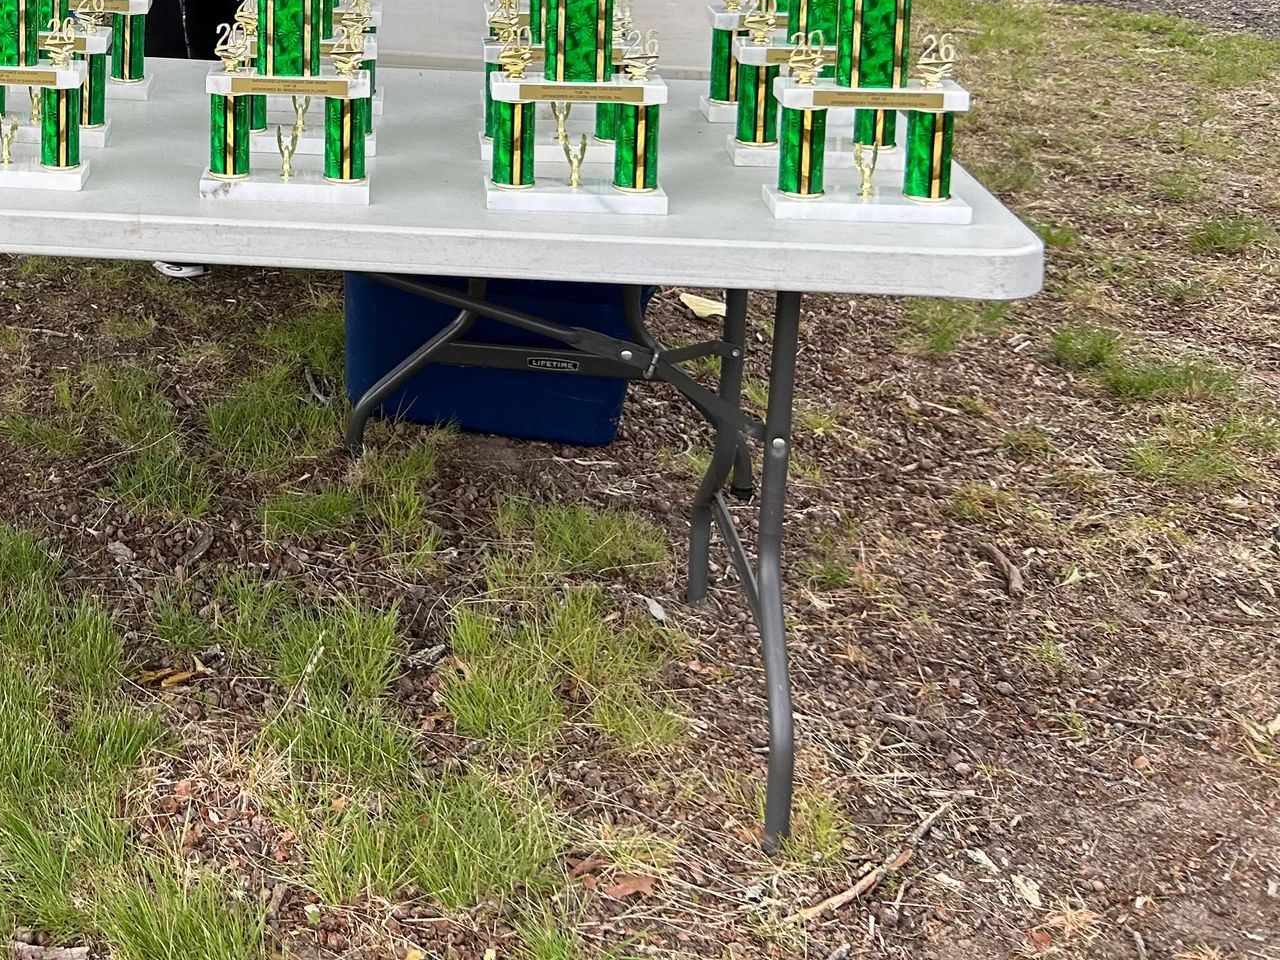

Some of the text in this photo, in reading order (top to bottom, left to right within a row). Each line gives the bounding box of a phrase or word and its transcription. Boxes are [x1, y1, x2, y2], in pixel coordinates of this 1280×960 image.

[45, 17, 75, 44] 26
[216, 23, 364, 52] 20 26
[499, 26, 659, 57] 20 26
[790, 30, 955, 64] 20 26
[532, 360, 574, 369] LIFETIME
